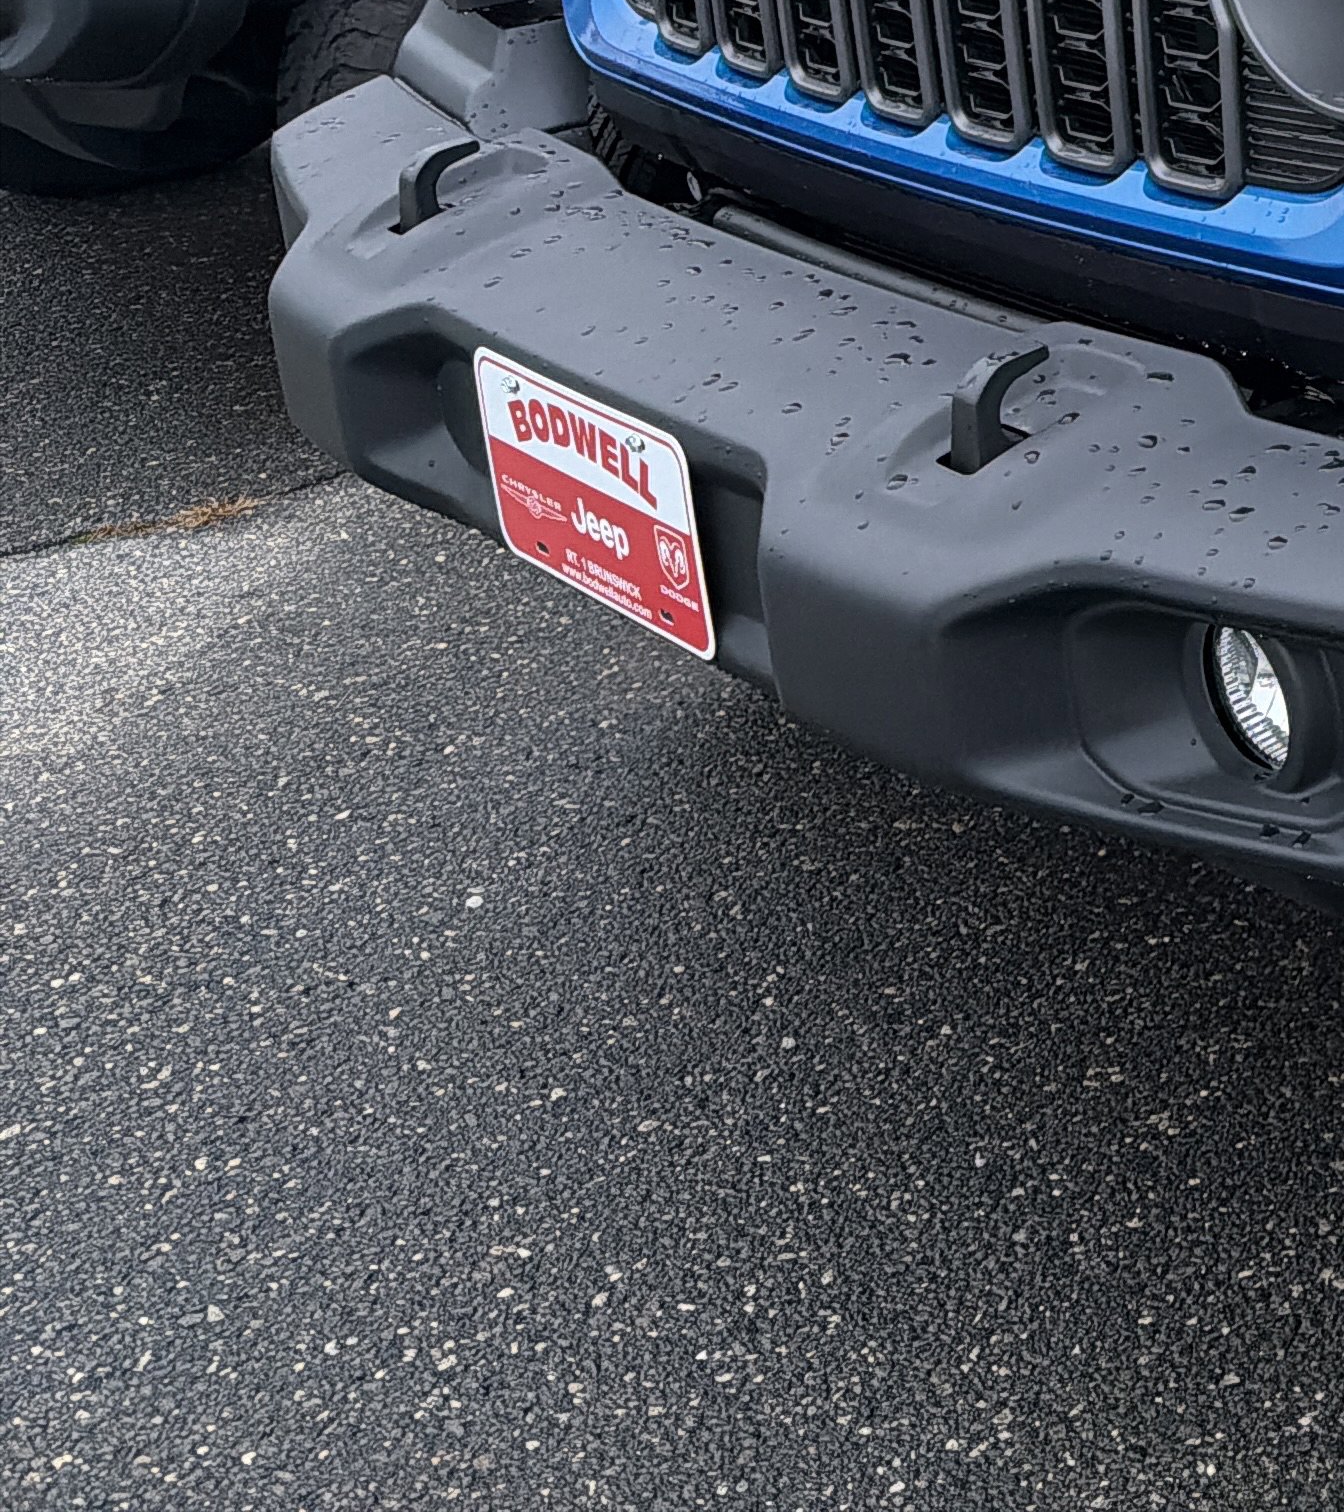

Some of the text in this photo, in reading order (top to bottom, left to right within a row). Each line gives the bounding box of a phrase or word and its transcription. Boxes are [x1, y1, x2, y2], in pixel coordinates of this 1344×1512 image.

[507, 398, 659, 510] BODWELL
[501, 474, 562, 511] CHRYSLER
[570, 497, 630, 561] Jeep
[564, 548, 580, 567] RT.
[588, 559, 643, 601] BRUNSWICK
[659, 584, 700, 613] DODGE
